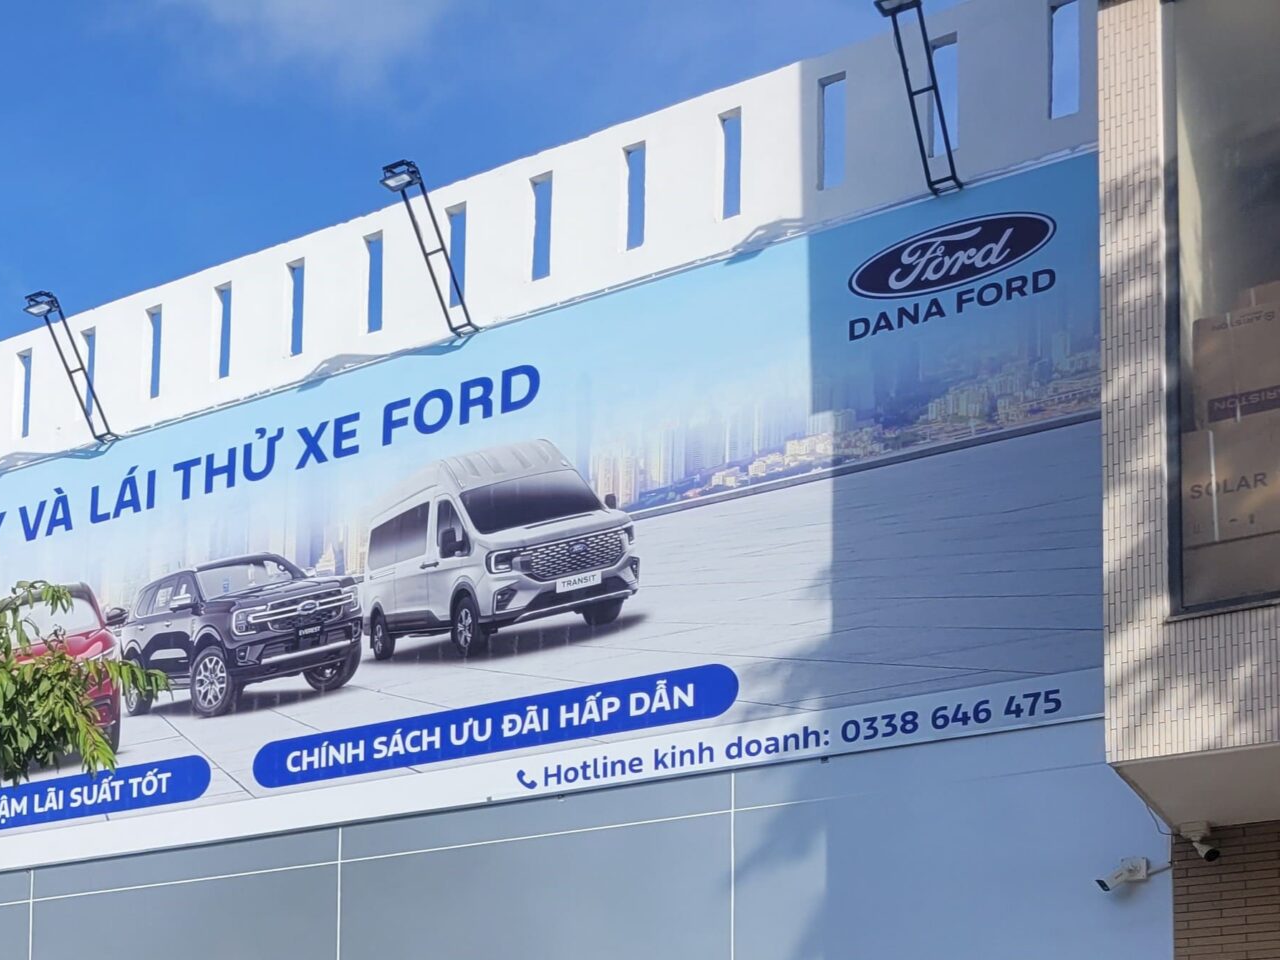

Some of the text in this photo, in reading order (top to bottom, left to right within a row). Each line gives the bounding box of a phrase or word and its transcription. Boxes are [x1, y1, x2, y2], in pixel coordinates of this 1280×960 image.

[887, 226, 1015, 290] Ford
[848, 268, 1057, 342] DANA FORD
[18, 486, 74, 542] VÀ
[89, 464, 157, 524] LÁI
[172, 426, 285, 500] THỬ
[295, 411, 361, 470] XE
[381, 363, 542, 446] FORD
[1190, 472, 1269, 500] SOLAR
[561, 574, 597, 589] TRANSIT
[298, 625, 323, 637] EVEREST
[286, 678, 695, 773] CHÍNH SÁCH ƯU ĐÃI HẤP DẪN
[543, 688, 1063, 787] Hotline kinh doanh: 0338 646 475
[34, 786, 65, 814] LÃI
[70, 775, 125, 808] SUẤT
[128, 768, 172, 799] TỐT
